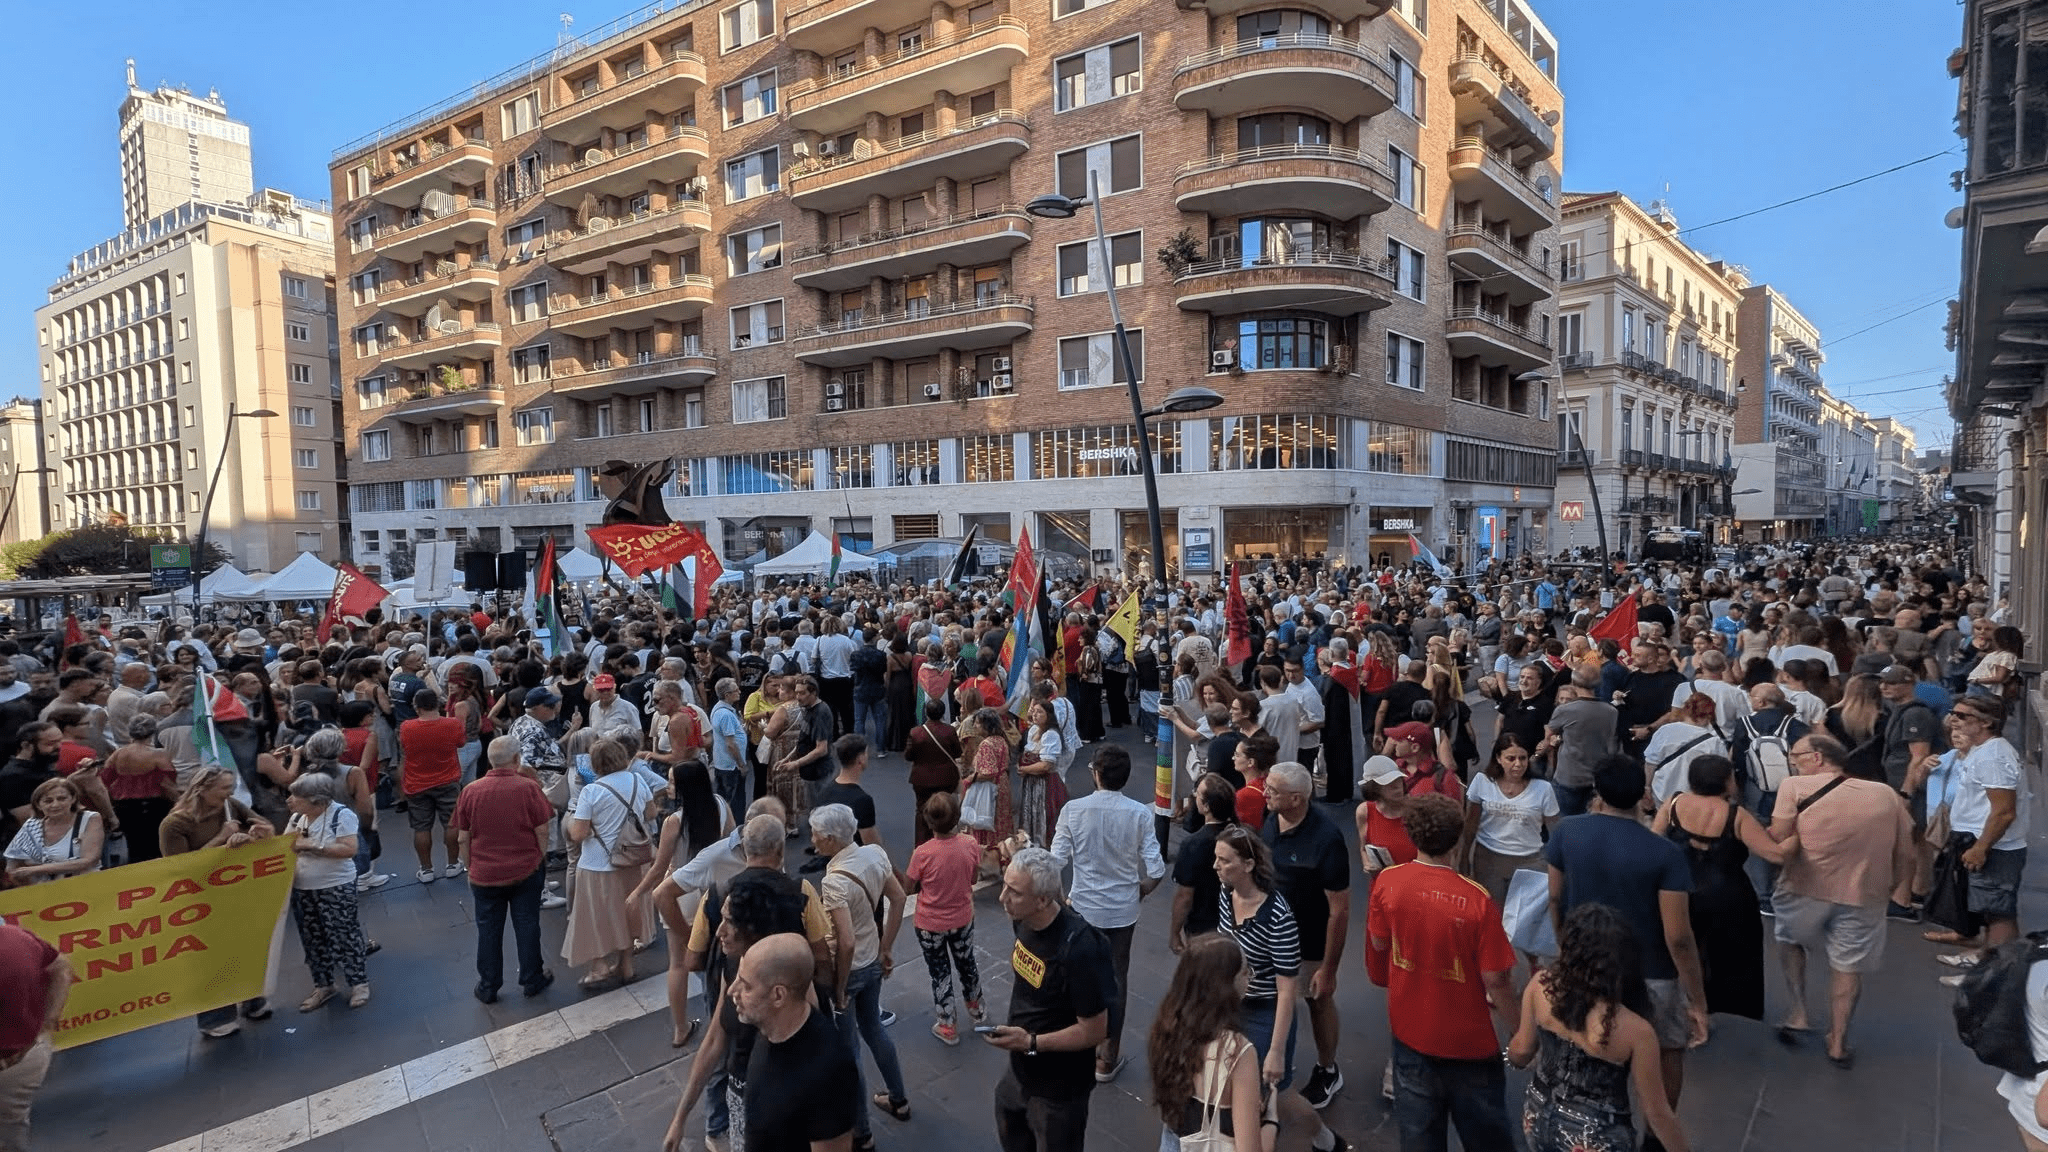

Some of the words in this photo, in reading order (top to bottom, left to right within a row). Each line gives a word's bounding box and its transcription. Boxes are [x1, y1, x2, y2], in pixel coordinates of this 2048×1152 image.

[1080, 447, 1136, 460] BERSHKA
[1384, 518, 1414, 530] BERSHKA
[1562, 506, 1581, 518] M
[117, 854, 288, 911] PACE
[58, 903, 212, 954] RMO
[72, 934, 209, 984] NIA
[55, 991, 172, 1032] RMO.ORG
